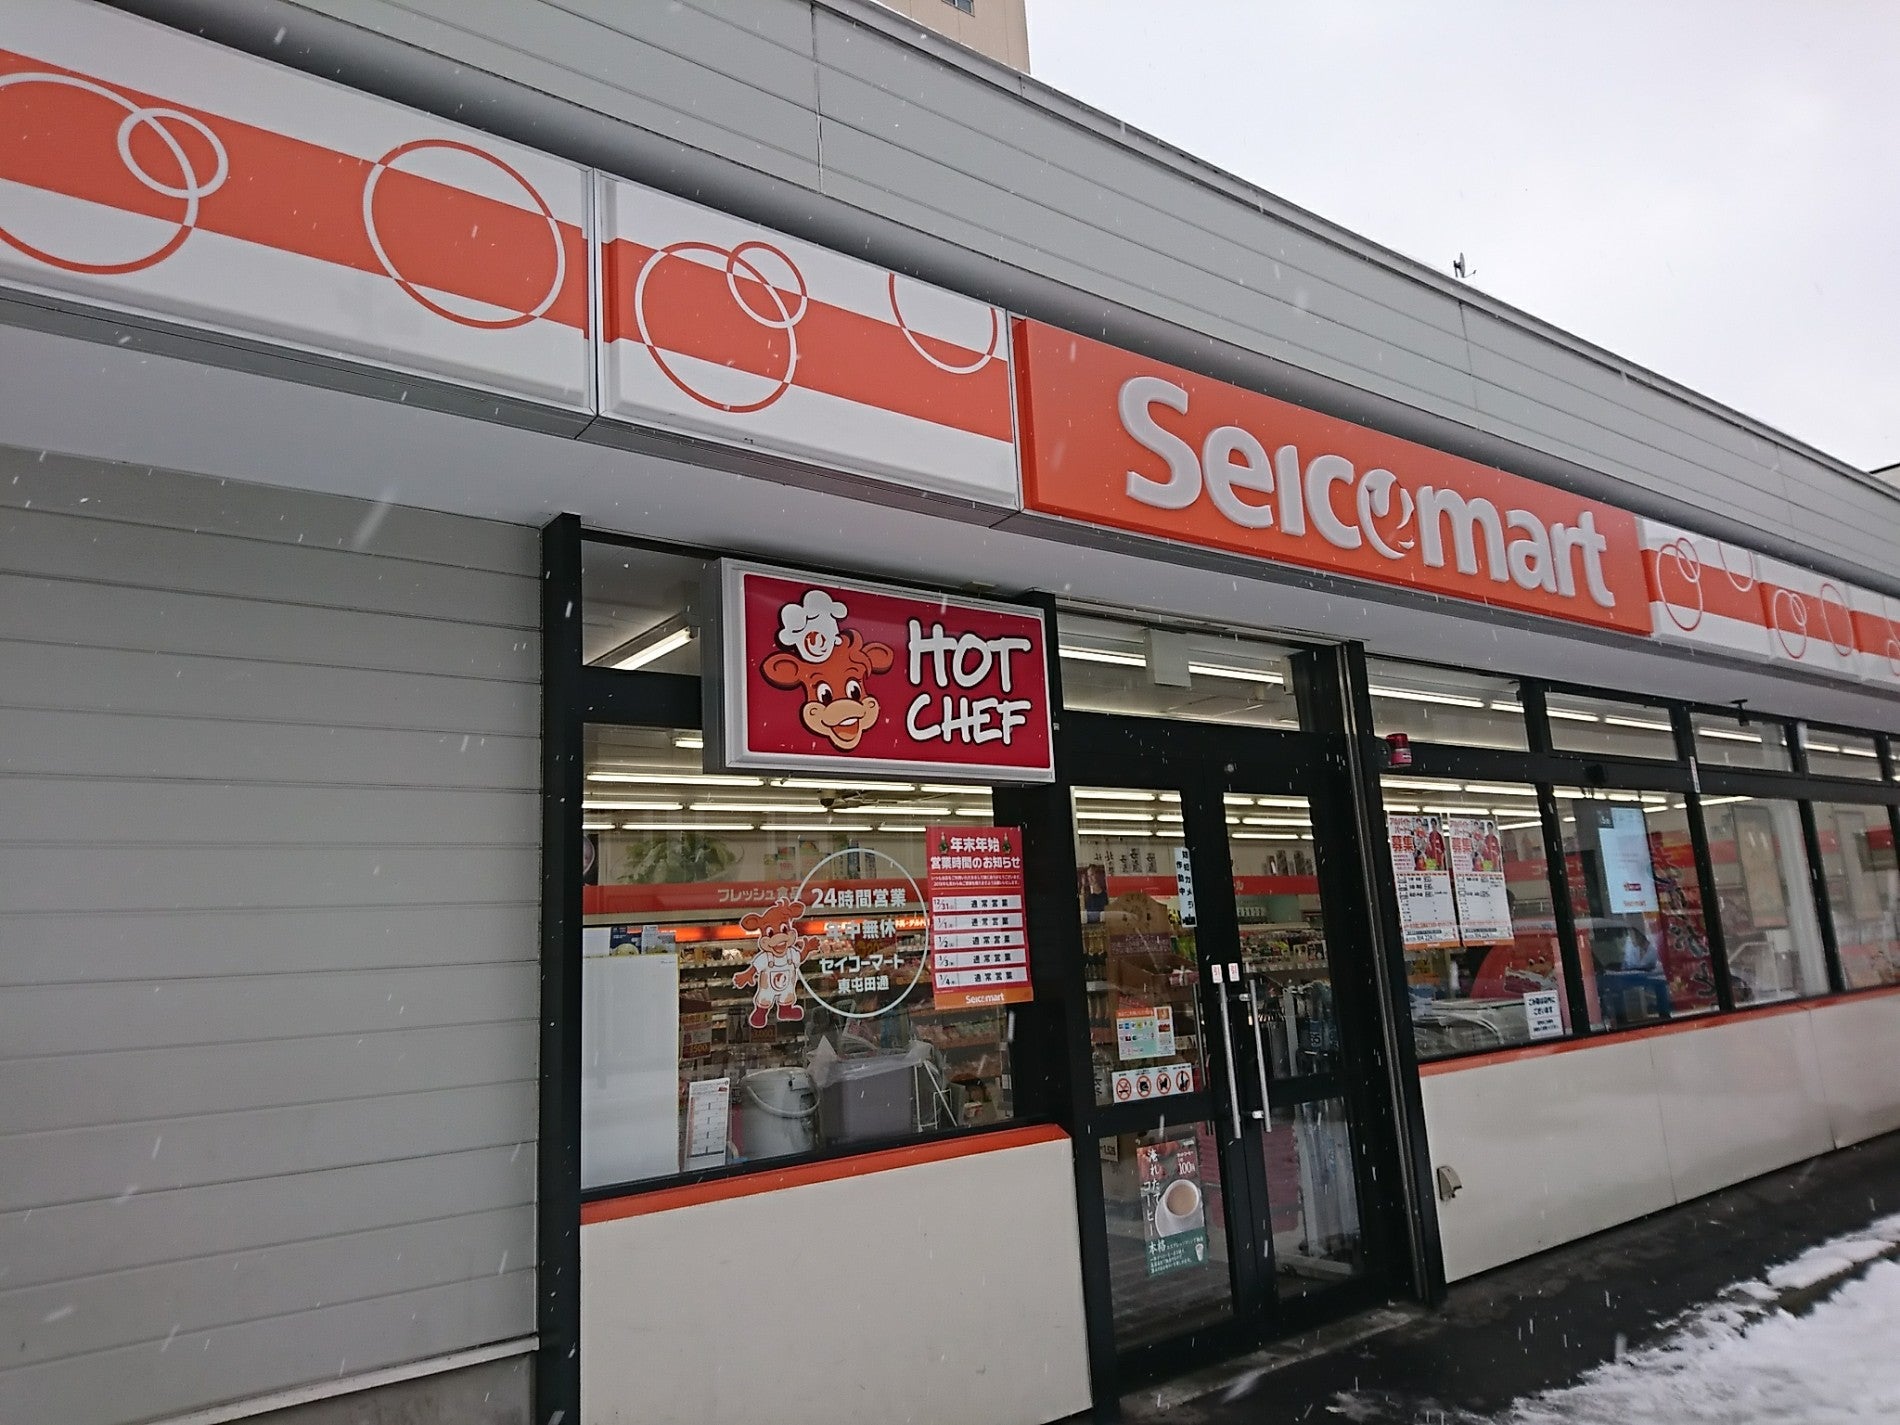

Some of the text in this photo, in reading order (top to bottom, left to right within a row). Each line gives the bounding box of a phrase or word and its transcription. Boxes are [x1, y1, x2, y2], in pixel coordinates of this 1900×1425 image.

[1118, 376, 1616, 608] Seicomart
[908, 619, 1032, 692] HOT
[907, 693, 1032, 745] CHEF
[950, 836, 1000, 853] 年末年始
[930, 856, 1021, 870] 営業時間のお知らせ
[717, 886, 803, 902] フレッシュ食品
[811, 887, 907, 909] 24時間営業
[971, 898, 1008, 909] 通常営業
[825, 918, 897, 942] 年中無休
[971, 917, 1009, 927] 通常営業
[972, 935, 1010, 945] 通常営業
[819, 953, 905, 975] セイコーマート
[973, 953, 1011, 964] 通常営業
[837, 975, 890, 994] 東屯田通
[974, 971, 1013, 982] 通常営業
[965, 993, 1005, 1004] Seicomart
[1143, 1180, 1155, 1237] コーヒー
[1149, 1239, 1166, 1255] 本格
